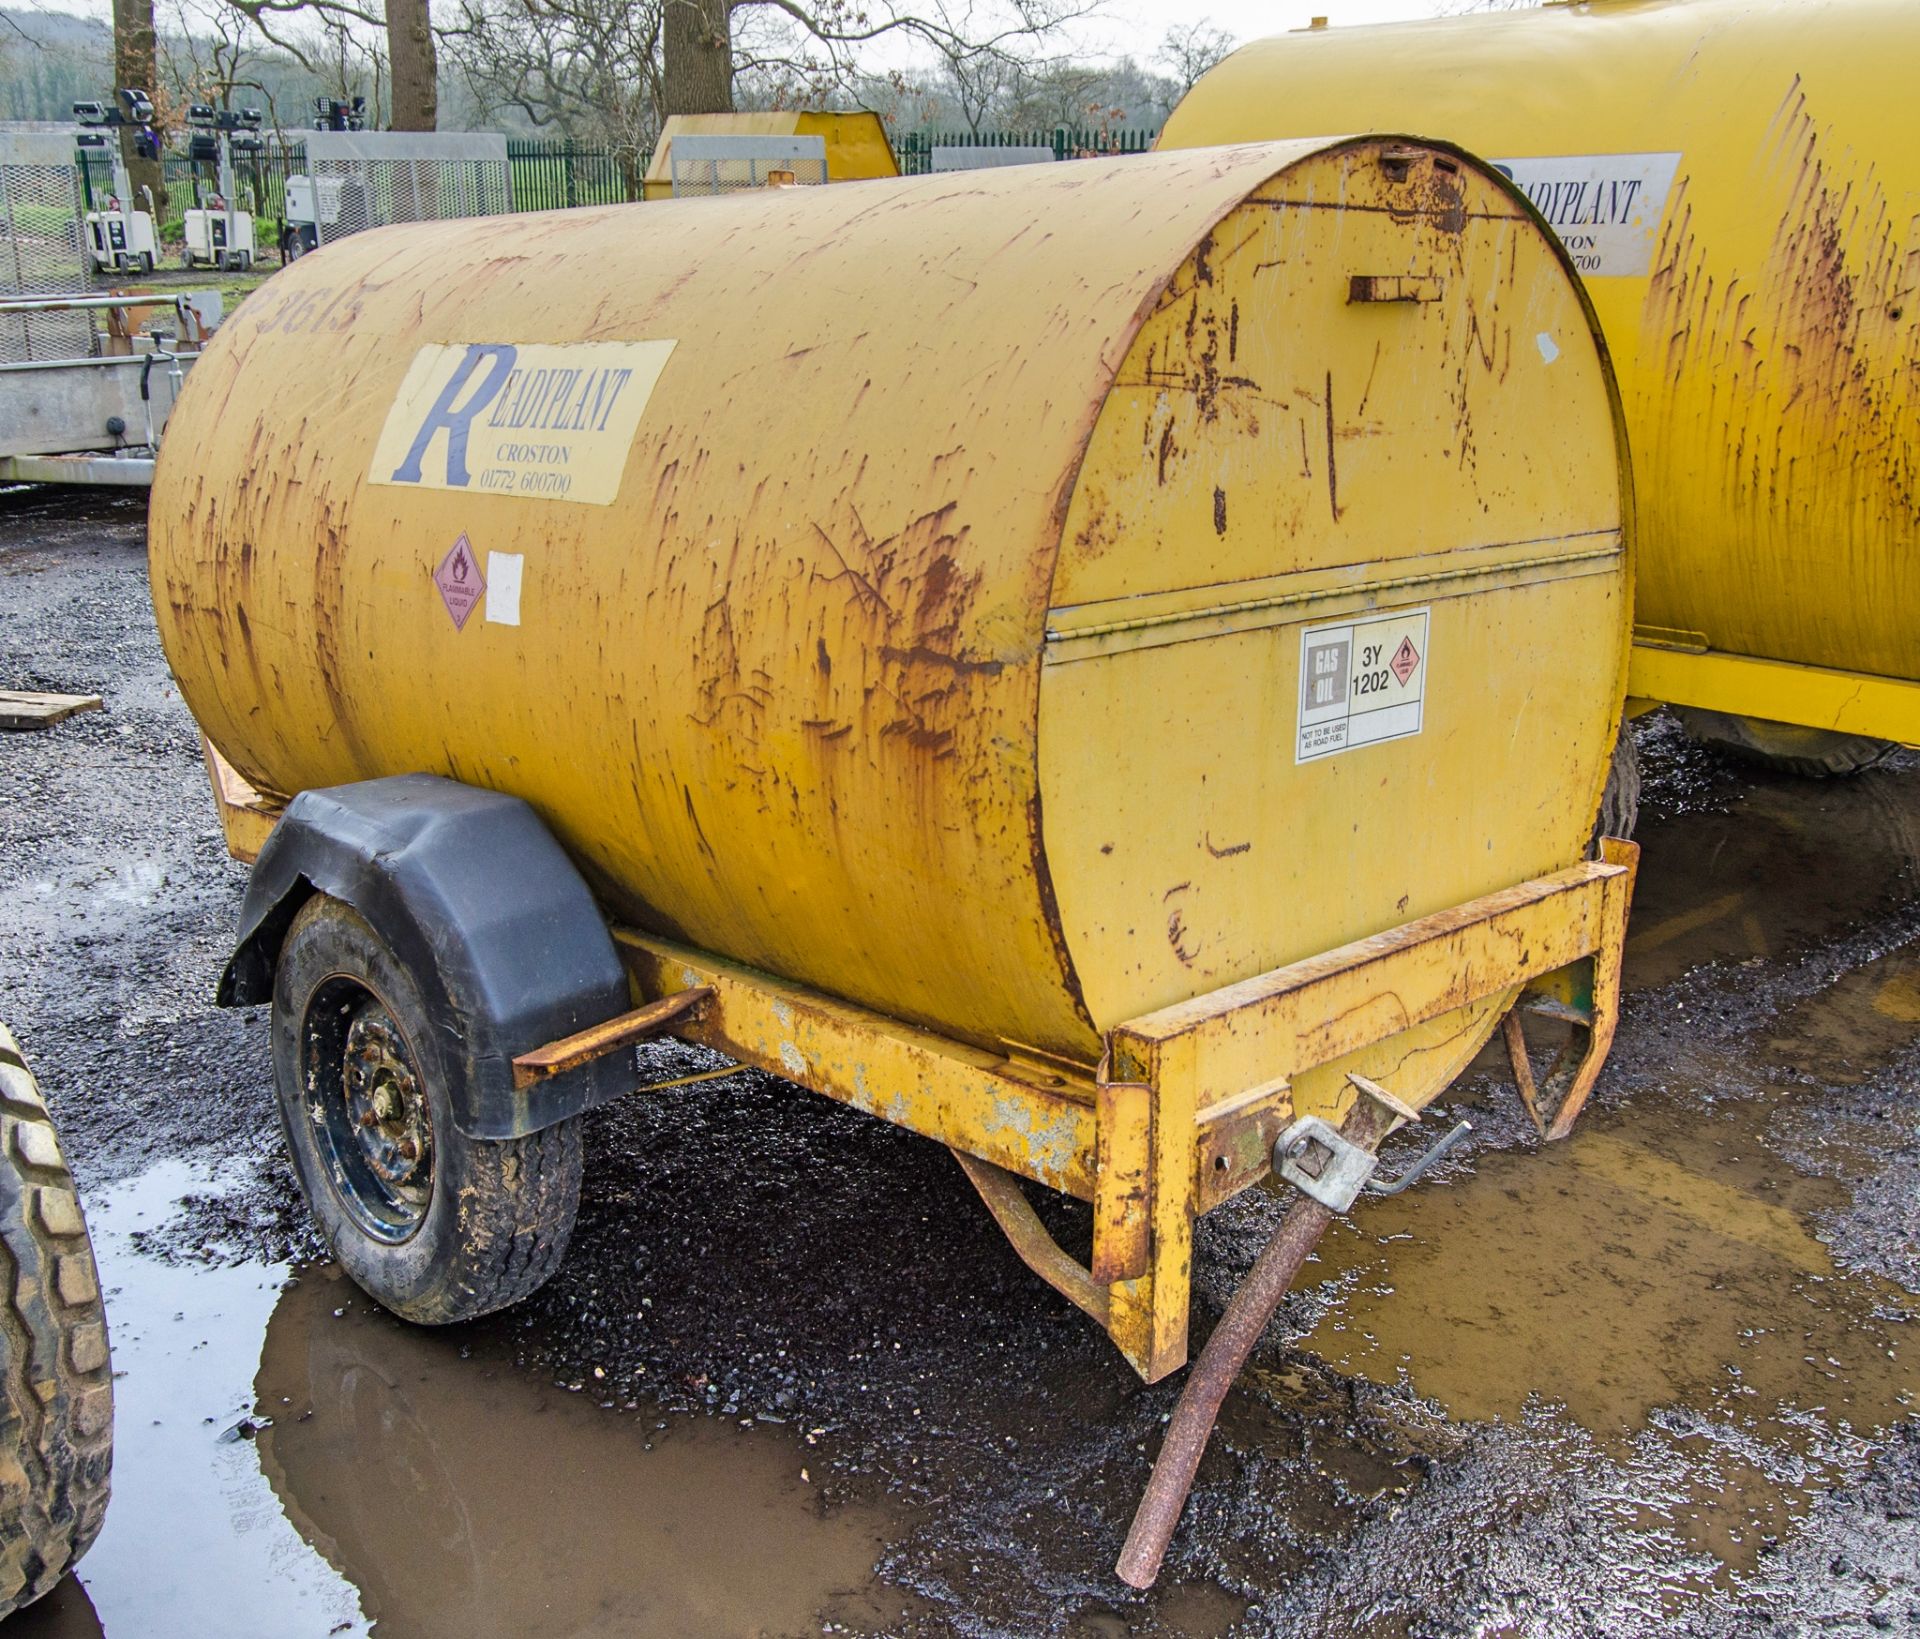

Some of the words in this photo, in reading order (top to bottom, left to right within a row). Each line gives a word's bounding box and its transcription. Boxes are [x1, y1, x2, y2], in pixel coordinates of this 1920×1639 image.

[1493, 164, 1642, 225] DYPLANT
[1558, 235, 1597, 249] TON
[1571, 254, 1601, 270] 700
[391, 344, 632, 486] READYPLANT
[496, 443, 572, 465] CROSTON
[480, 468, 516, 490] 01772
[520, 471, 571, 493] 600700
[442, 583, 475, 596] FLAMMABLE
[1315, 647, 1339, 675] GAS
[1362, 644, 1383, 668] 3Y
[1316, 677, 1334, 704] OIL
[1353, 669, 1390, 696] 1202
[1302, 730, 1313, 740] NOT
[1314, 728, 1322, 738] TO
[1323, 726, 1331, 736] BE
[1332, 723, 1346, 733] USED
[1304, 740, 1313, 750] AS
[1313, 736, 1329, 746] ROAD
[1329, 733, 1343, 742] FUEL
